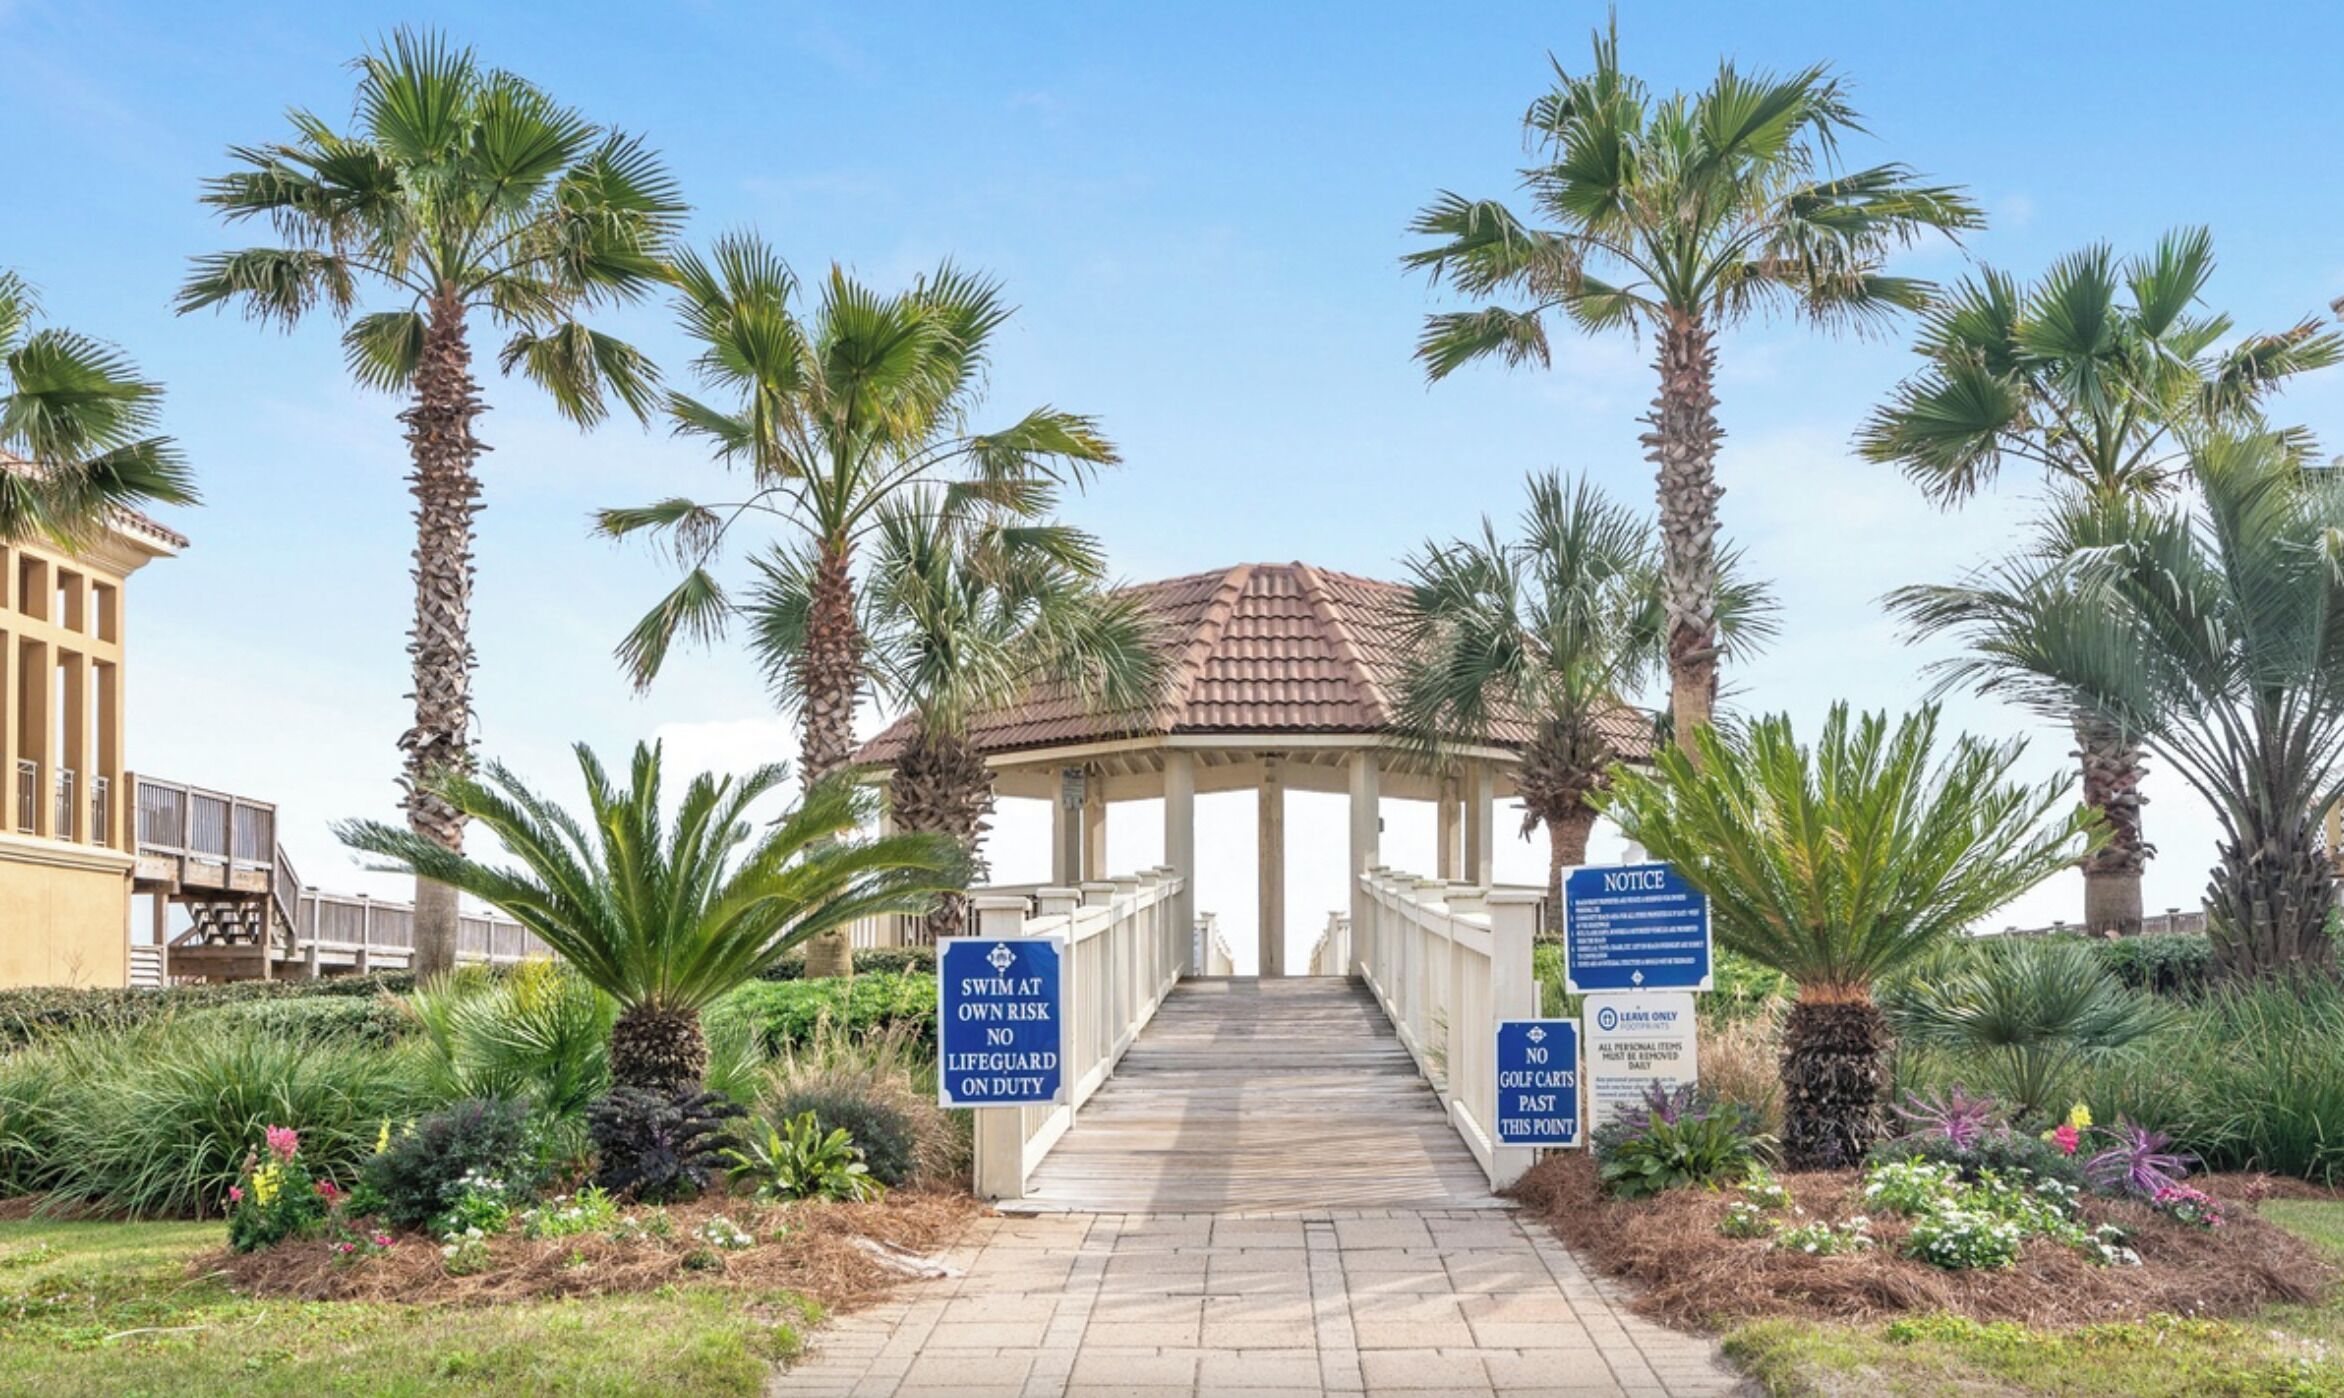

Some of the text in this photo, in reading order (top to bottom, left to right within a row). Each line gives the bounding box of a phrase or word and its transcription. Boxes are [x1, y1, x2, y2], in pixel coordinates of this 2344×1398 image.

[1604, 871, 1665, 891] NOTICE
[961, 978, 1042, 996] SWIM AT
[958, 1002, 1050, 1021] OWN RISK
[1620, 1011, 1678, 1021] LEAVE ONLY
[1620, 1022, 1670, 1030] FOOTPRINTS
[986, 1028, 1014, 1046] NO
[1598, 1042, 1682, 1051] ALL PERSONAL ITEMS
[948, 1052, 1057, 1071] LIFEGUARD
[1525, 1047, 1548, 1064] NO
[1602, 1052, 1680, 1061] MUST BE REMOVED
[1628, 1062, 1652, 1070] DAILY
[961, 1077, 1044, 1096] ON DUTY
[1500, 1071, 1574, 1088] GOLF CARTS
[1518, 1095, 1556, 1112] PAST
[1501, 1118, 1574, 1135] THIS POINT
